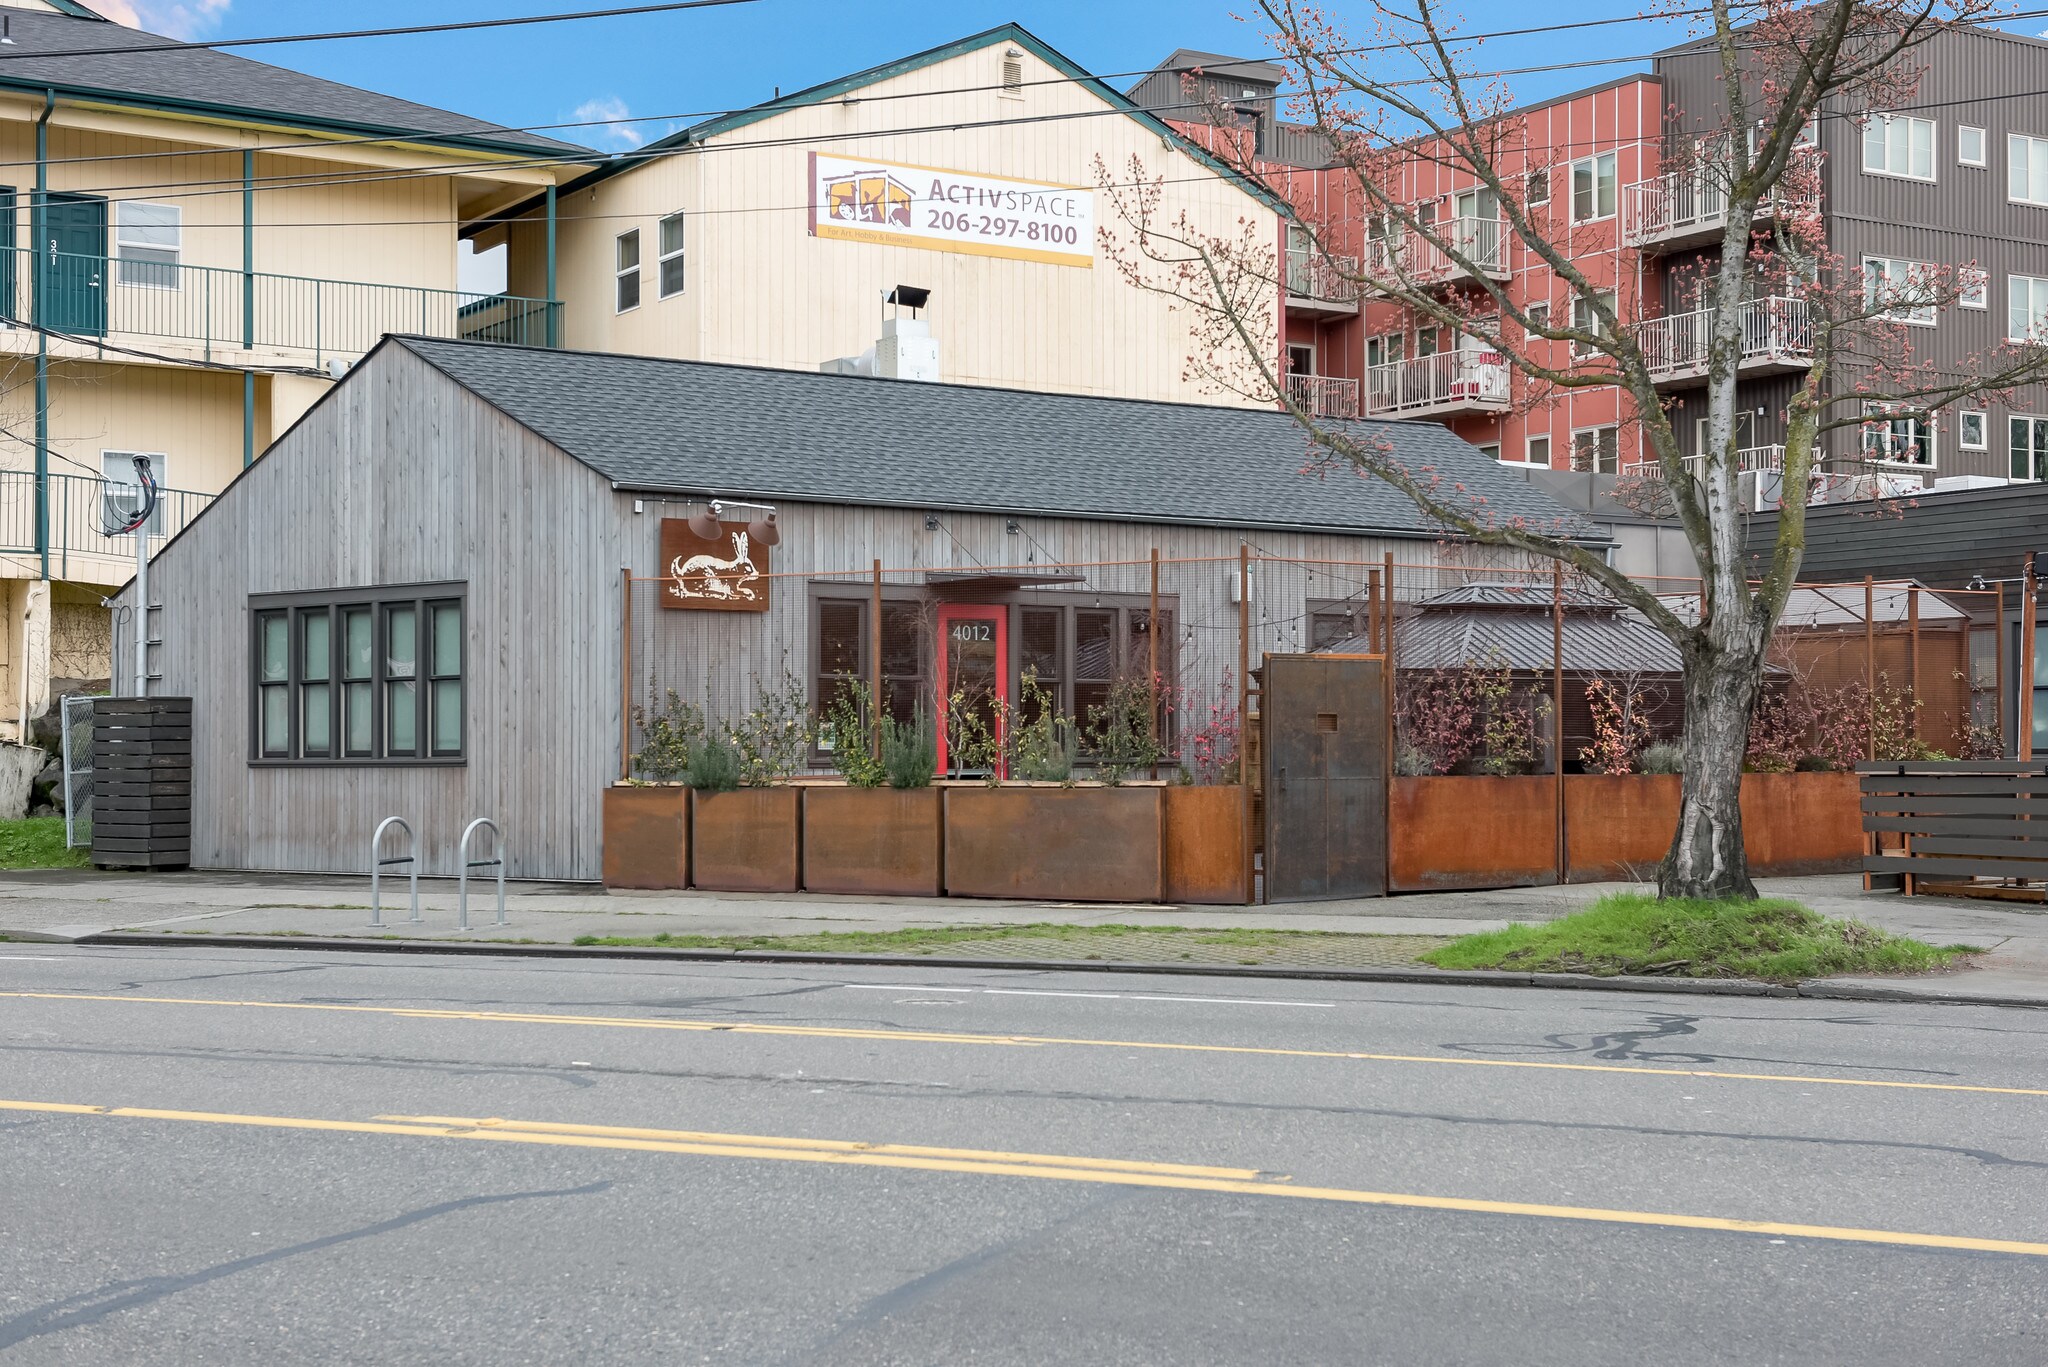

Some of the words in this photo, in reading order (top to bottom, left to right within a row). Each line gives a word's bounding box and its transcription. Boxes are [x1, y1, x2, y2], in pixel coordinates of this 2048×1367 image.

[827, 227, 839, 236] For
[854, 231, 877, 242] Hobby
[885, 234, 913, 245] Business
[927, 209, 1078, 246] 206-297-8100
[952, 625, 990, 641] 4012
